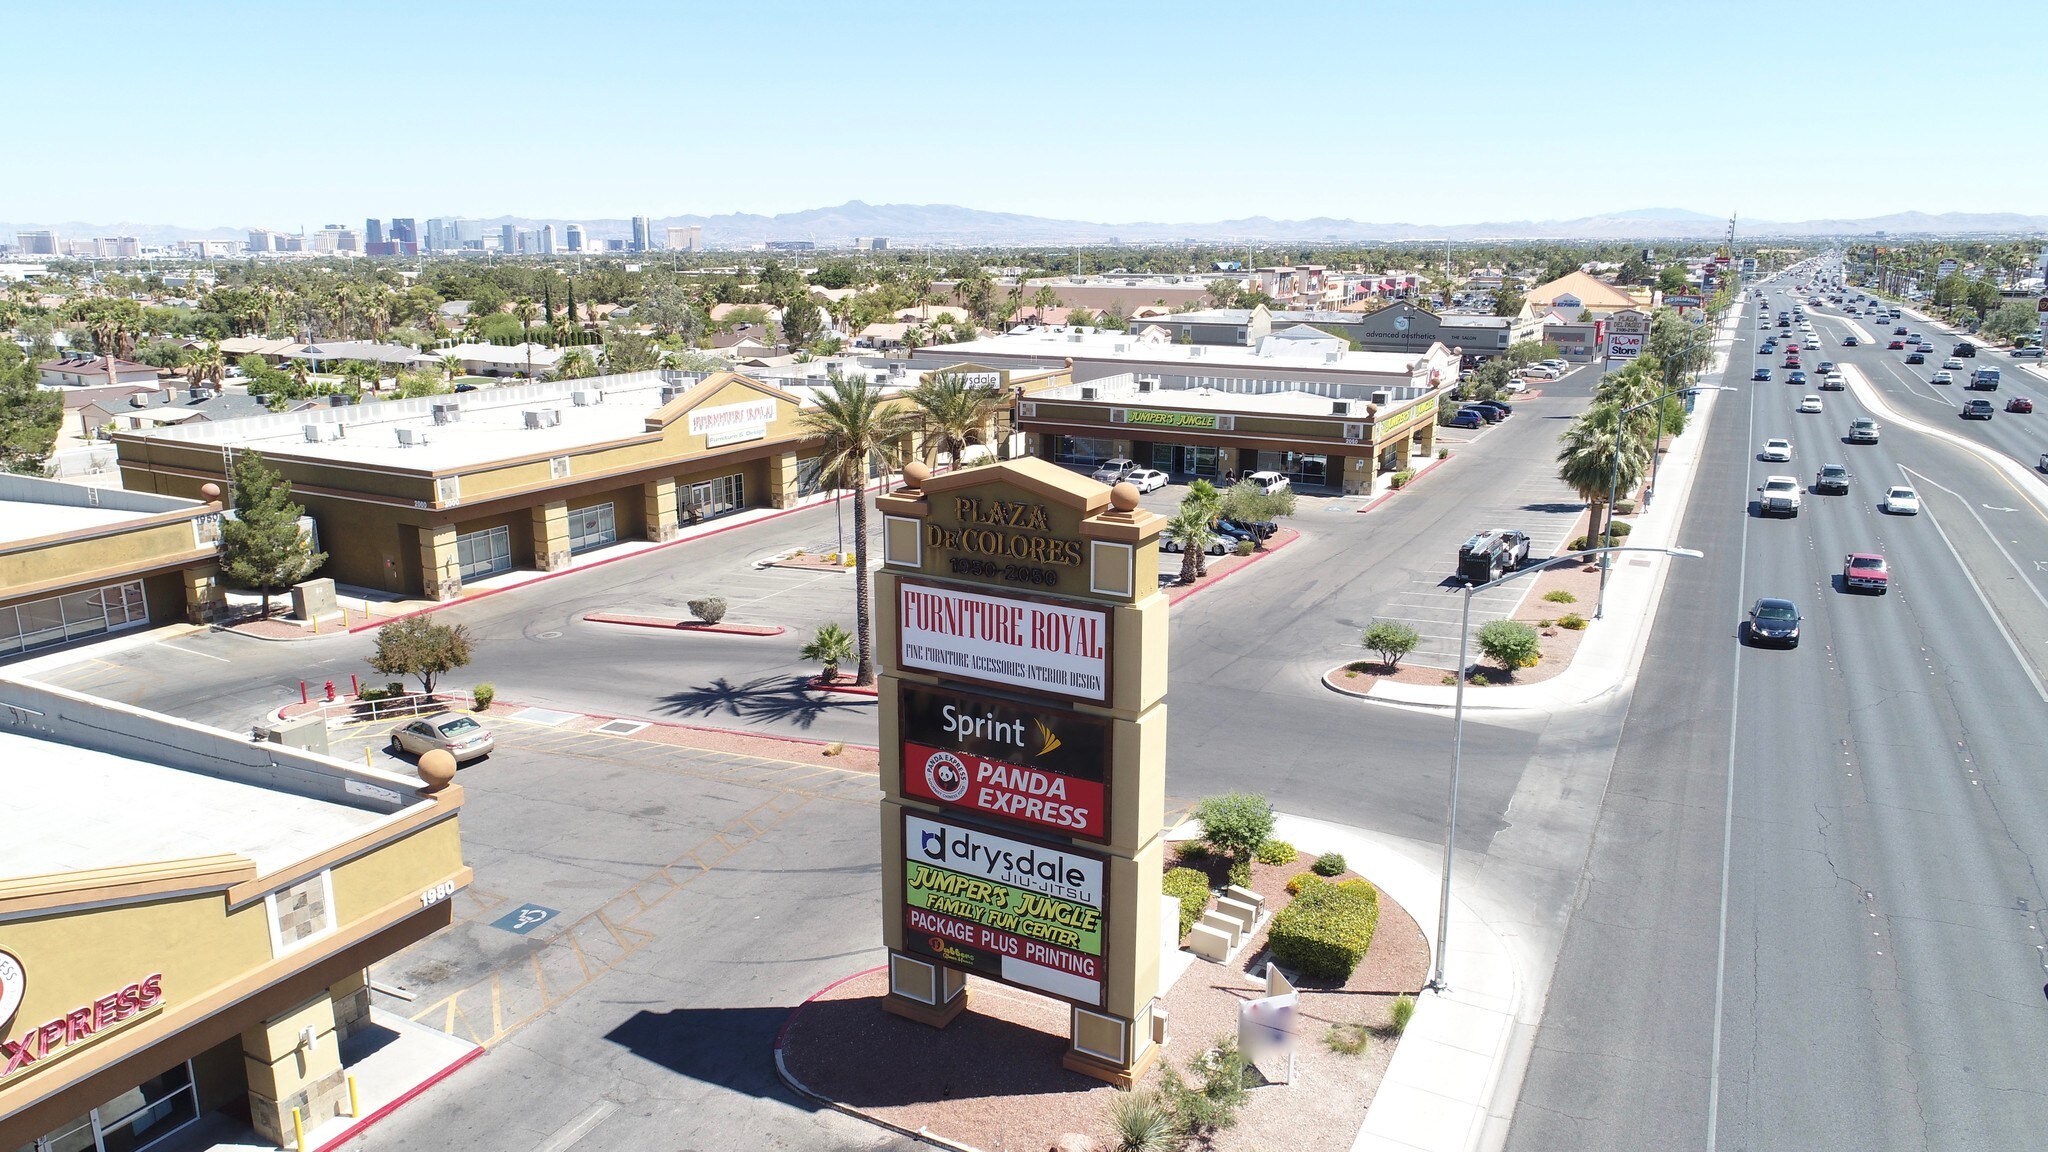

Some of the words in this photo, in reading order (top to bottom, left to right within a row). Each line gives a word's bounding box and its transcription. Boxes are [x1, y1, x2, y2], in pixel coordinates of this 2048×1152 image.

[1366, 331, 1400, 339] advanced
[1401, 332, 1436, 340] aesthetics
[1612, 346, 1637, 355] Store
[1129, 411, 1174, 424] JUMPER'S
[1177, 415, 1215, 426] JUNGLE
[414, 500, 427, 509] 2000
[955, 496, 1049, 531] PLAZA
[950, 556, 1058, 586] 1950-2050
[904, 590, 1023, 647] FURNITURE
[1031, 609, 1103, 660] ROYAL
[905, 643, 923, 660] FINE
[1070, 671, 1101, 691] DESIGN
[942, 704, 1025, 747] Sprint
[926, 754, 943, 773] PANDA
[945, 754, 967, 781] EXPRESS
[976, 761, 1067, 800] PANDA
[977, 787, 1089, 829] EXPRESS
[952, 833, 1085, 888] drysdale
[420, 880, 455, 907] 1980
[909, 866, 1010, 908] JUMPER'S
[1013, 893, 1100, 932] JUNGLE
[1001, 871, 1091, 902] JIU-JITSU
[926, 893, 985, 921] FAMILY
[987, 909, 1020, 931] FUN
[1022, 919, 1080, 948] CENTER
[911, 911, 974, 943] PACKAGE
[981, 930, 1018, 955] PLUS
[1025, 943, 1095, 976] PRINTING
[0, 973, 162, 1078] XPRESS
